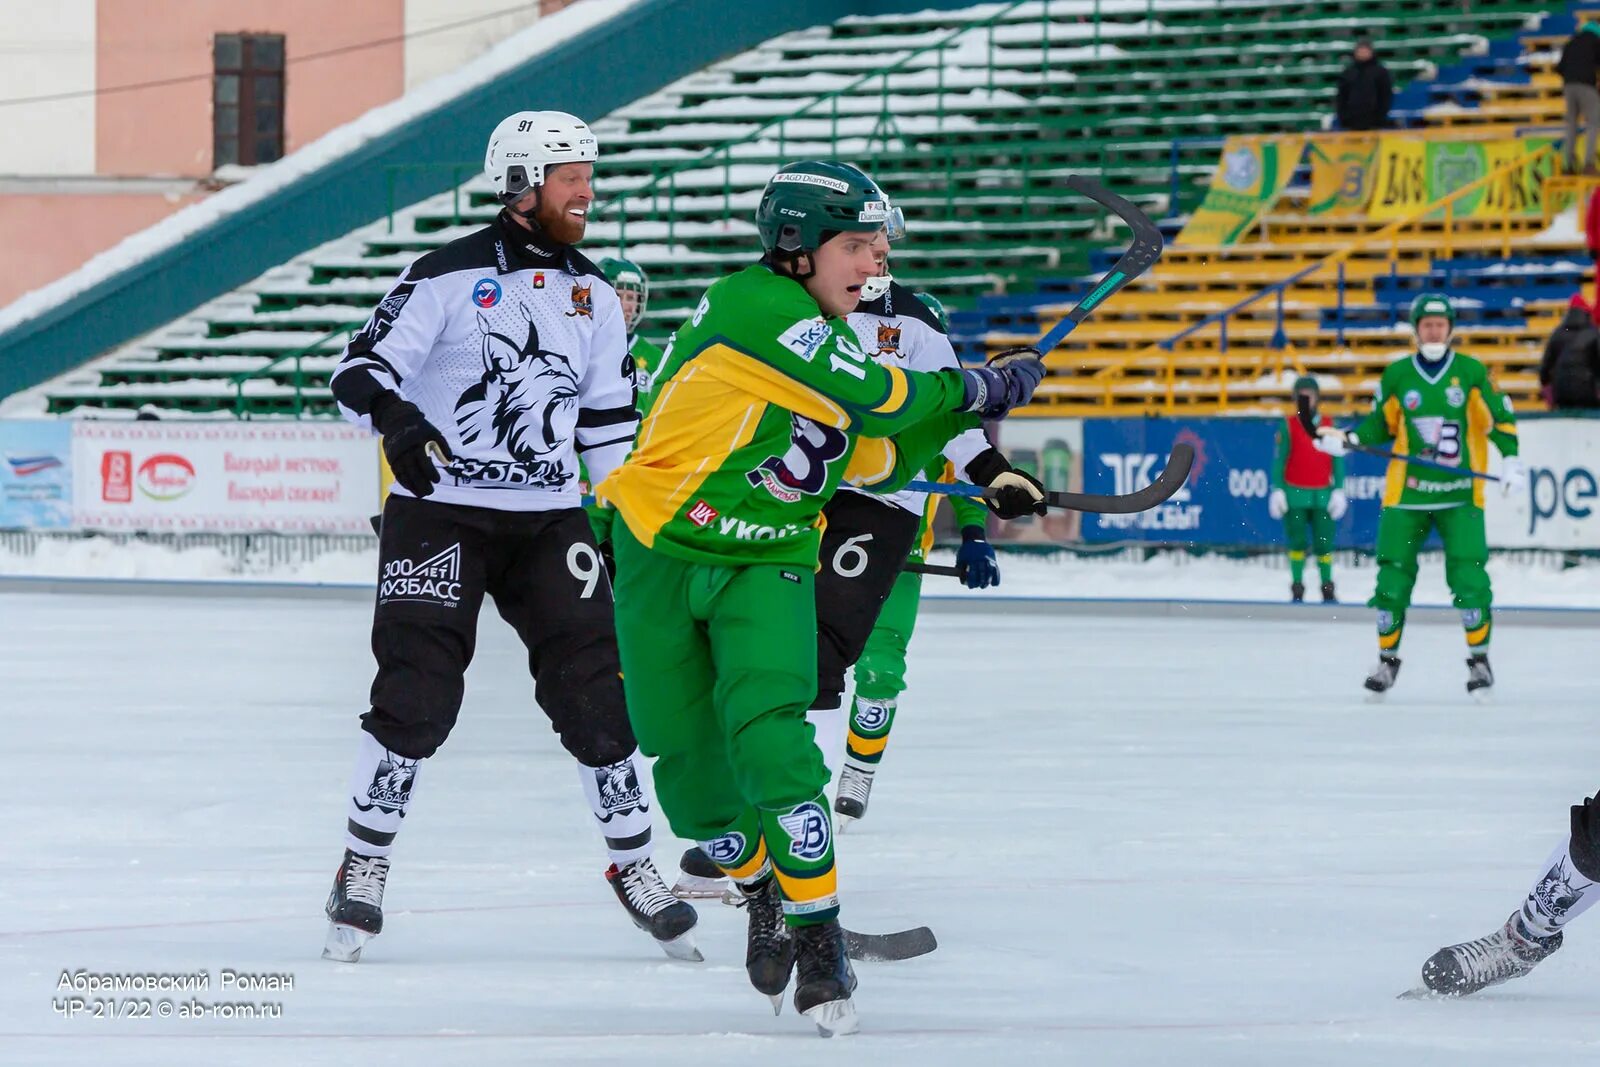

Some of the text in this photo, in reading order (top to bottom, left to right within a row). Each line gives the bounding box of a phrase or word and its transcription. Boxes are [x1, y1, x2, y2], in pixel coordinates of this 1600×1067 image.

[518, 120, 533, 133] 91
[784, 174, 846, 191] AGD Diamonds
[780, 207, 807, 219] CCM
[1229, 469, 1268, 498] ООО
[832, 533, 874, 578] 6
[382, 559, 413, 580] 300
[379, 577, 462, 601] КУЗБАСС
[367, 783, 413, 804] КУЗБАСС
[600, 786, 643, 808] КУЗБАСС
